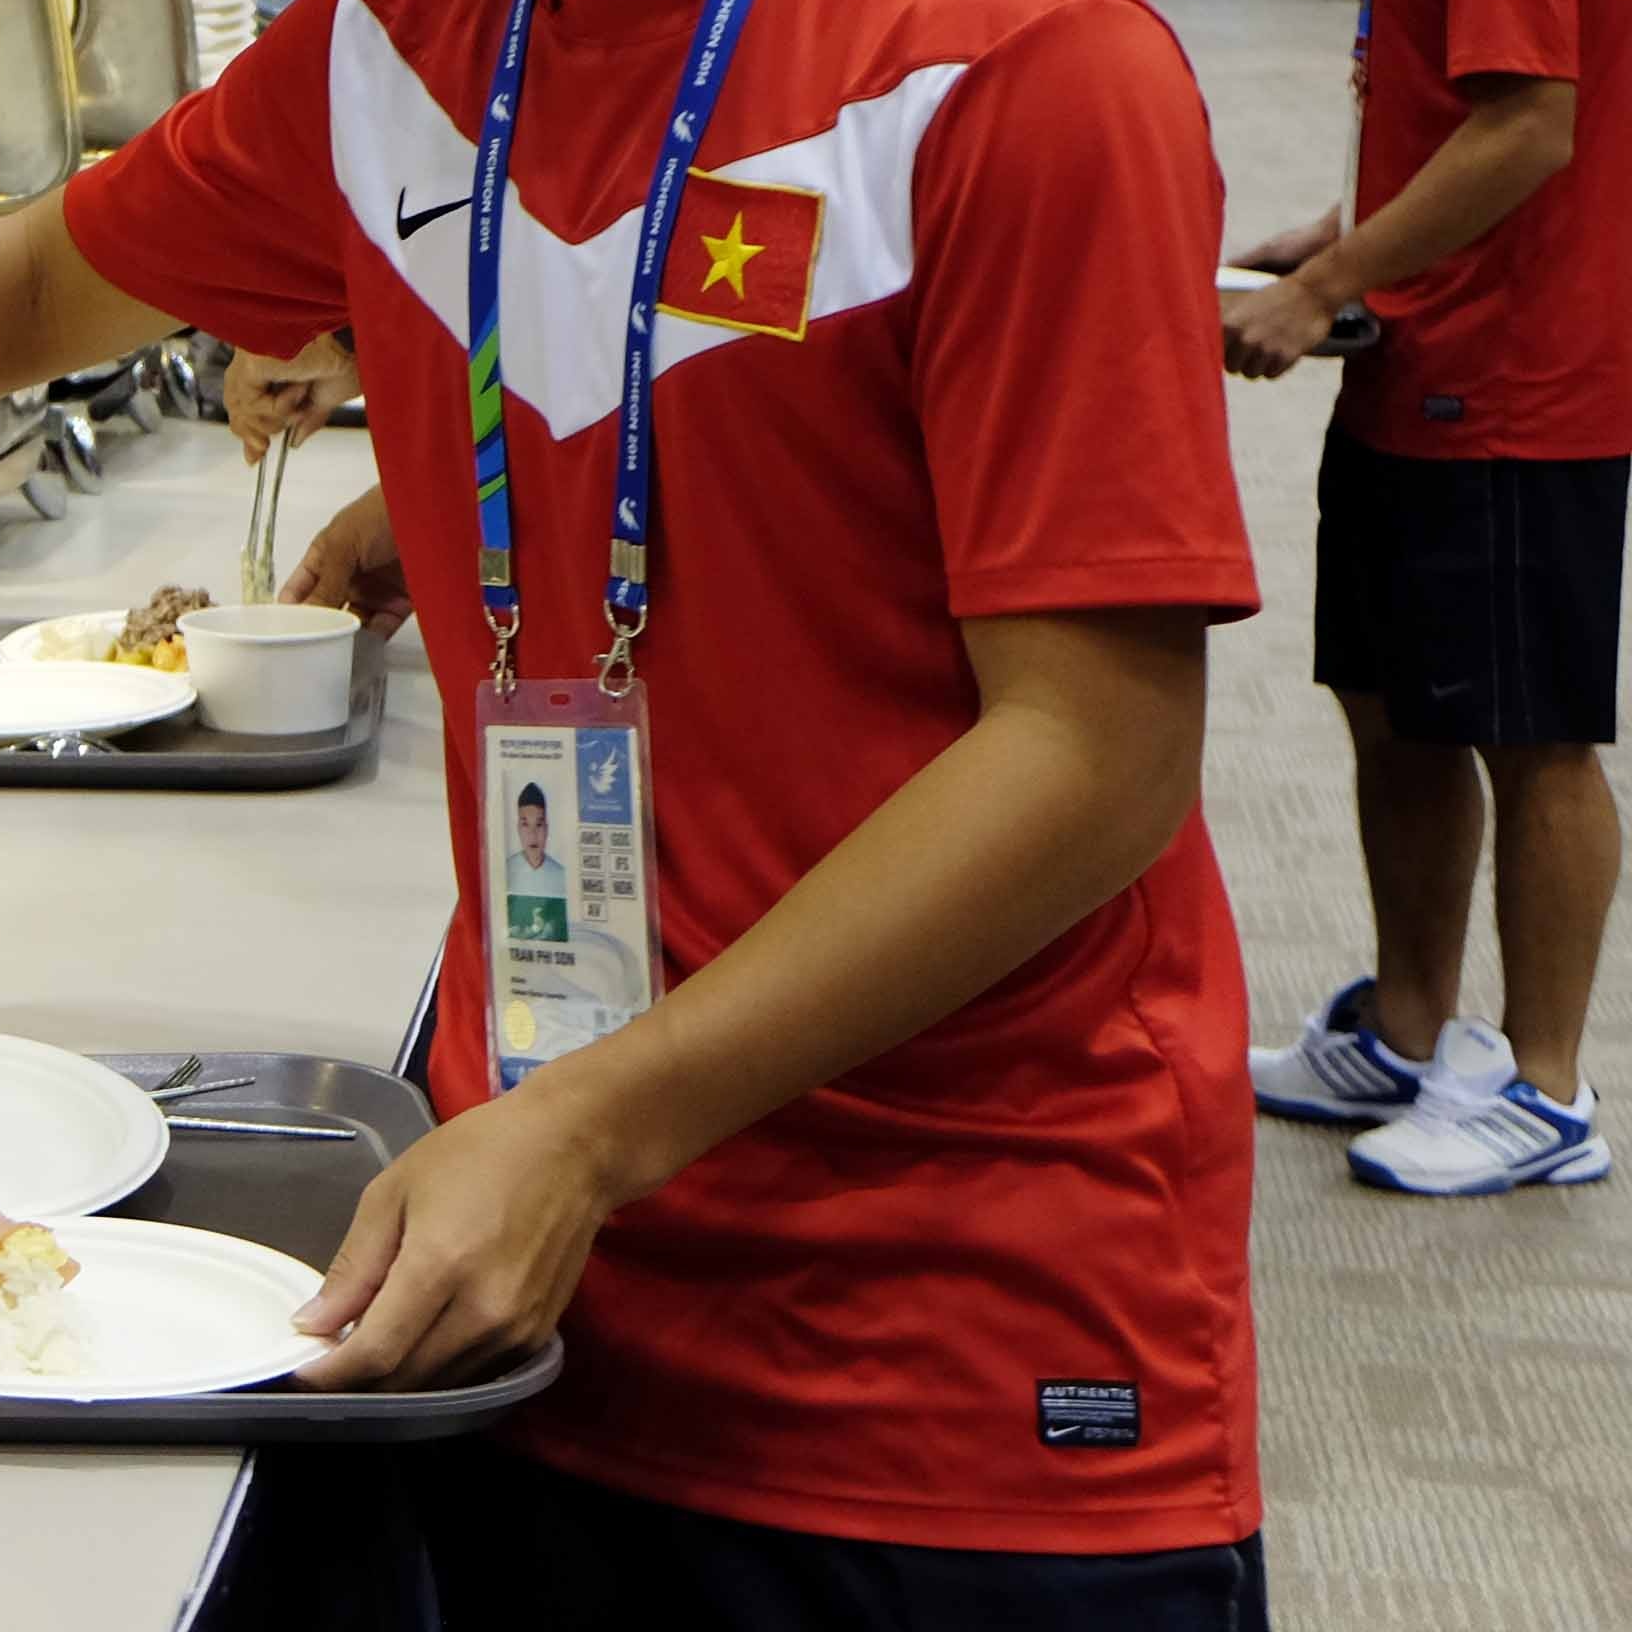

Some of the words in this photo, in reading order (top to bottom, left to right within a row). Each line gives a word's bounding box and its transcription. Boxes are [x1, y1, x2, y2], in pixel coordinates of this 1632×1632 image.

[693, 50, 717, 87] 2014
[481, 137, 500, 213] INCHEON
[647, 157, 679, 235] INCHEON
[480, 214, 492, 254] 2014
[642, 235, 659, 276] 2014
[627, 350, 642, 430] INCHEON
[626, 432, 638, 471] 2014
[1042, 1386, 1134, 1400] AUTHENTIC
